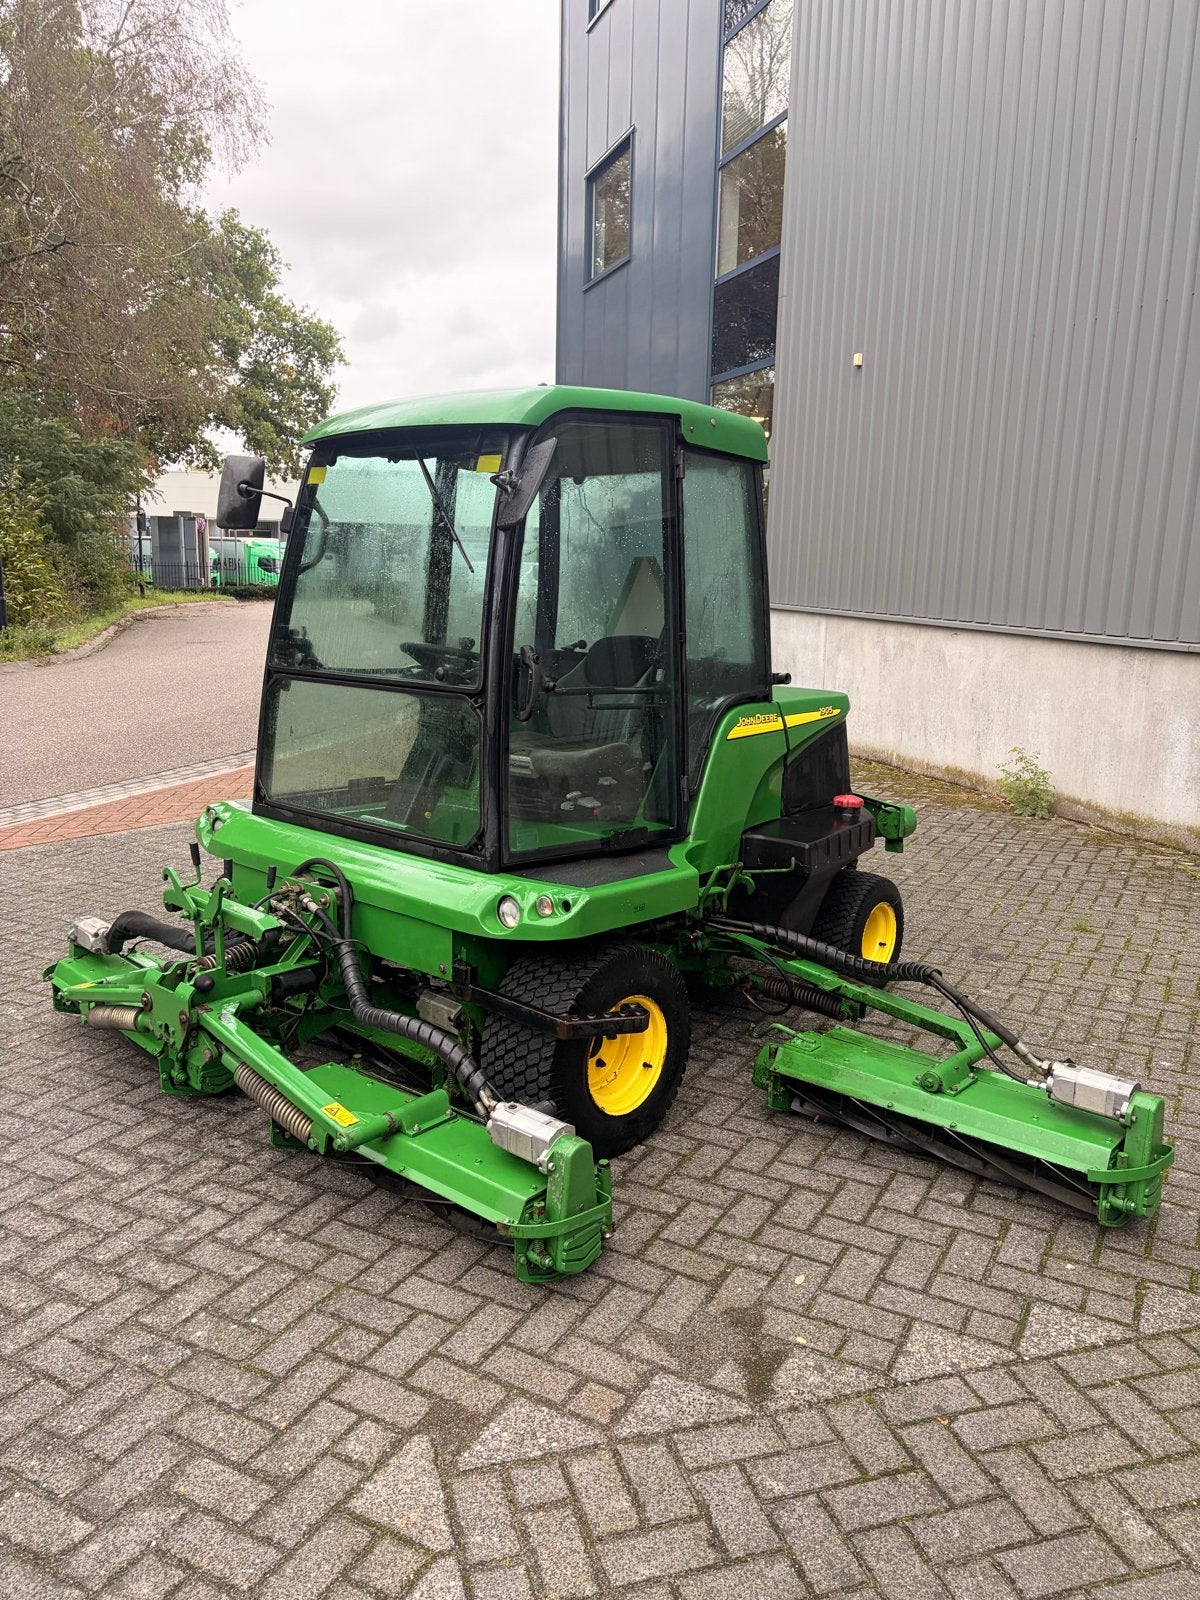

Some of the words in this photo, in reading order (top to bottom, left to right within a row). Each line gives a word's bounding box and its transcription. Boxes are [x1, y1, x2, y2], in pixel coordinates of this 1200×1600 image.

[819, 705, 834, 716] 1905
[736, 716, 756, 727] JOHN
[756, 713, 779, 725] DEERE
